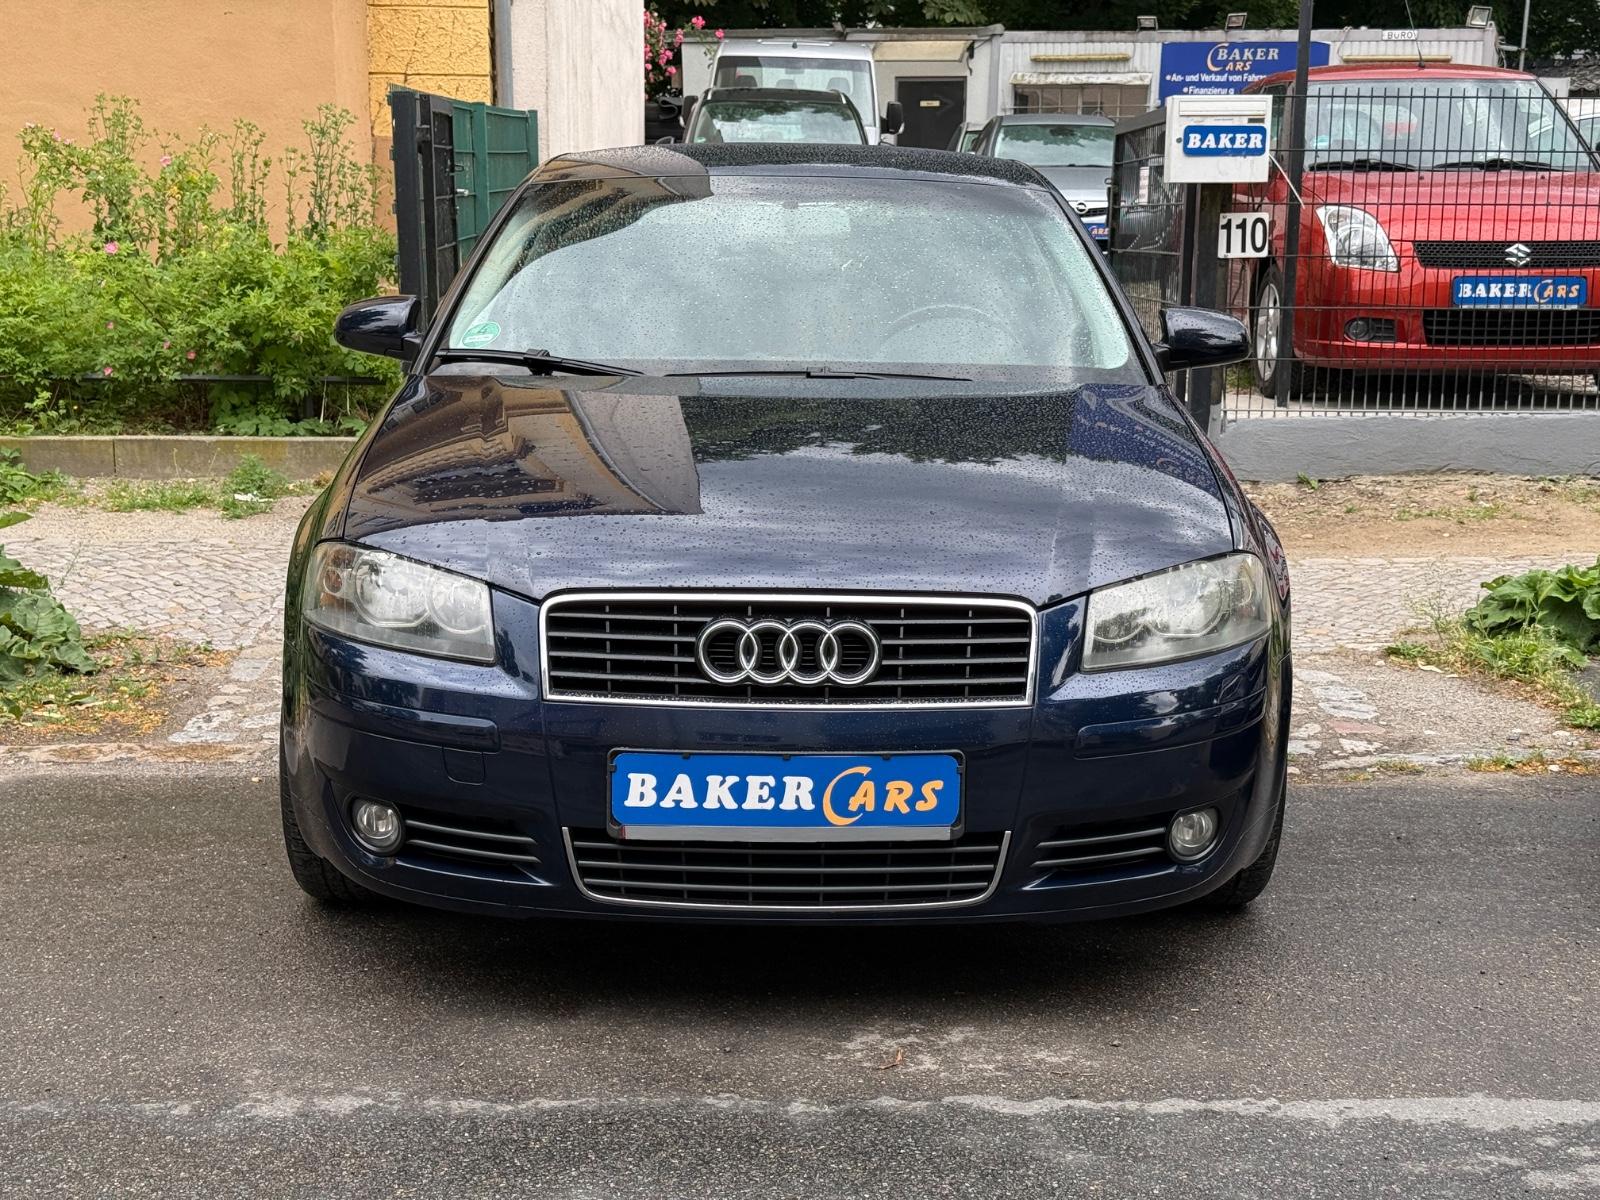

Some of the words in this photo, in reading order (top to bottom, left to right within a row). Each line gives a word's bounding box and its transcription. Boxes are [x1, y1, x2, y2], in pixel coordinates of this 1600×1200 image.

[1216, 48, 1279, 61] BAKER
[1171, 73, 1185, 82] An-
[1185, 73, 1199, 82] und
[1200, 73, 1228, 82] Verkauf
[1228, 74, 1243, 82] von
[1187, 133, 1263, 149] BAKER
[1220, 217, 1267, 254] 110
[1458, 283, 1532, 298] BAKER
[1533, 279, 1580, 303] CARS
[623, 772, 815, 811] BAKER
[822, 766, 944, 826] CARS
